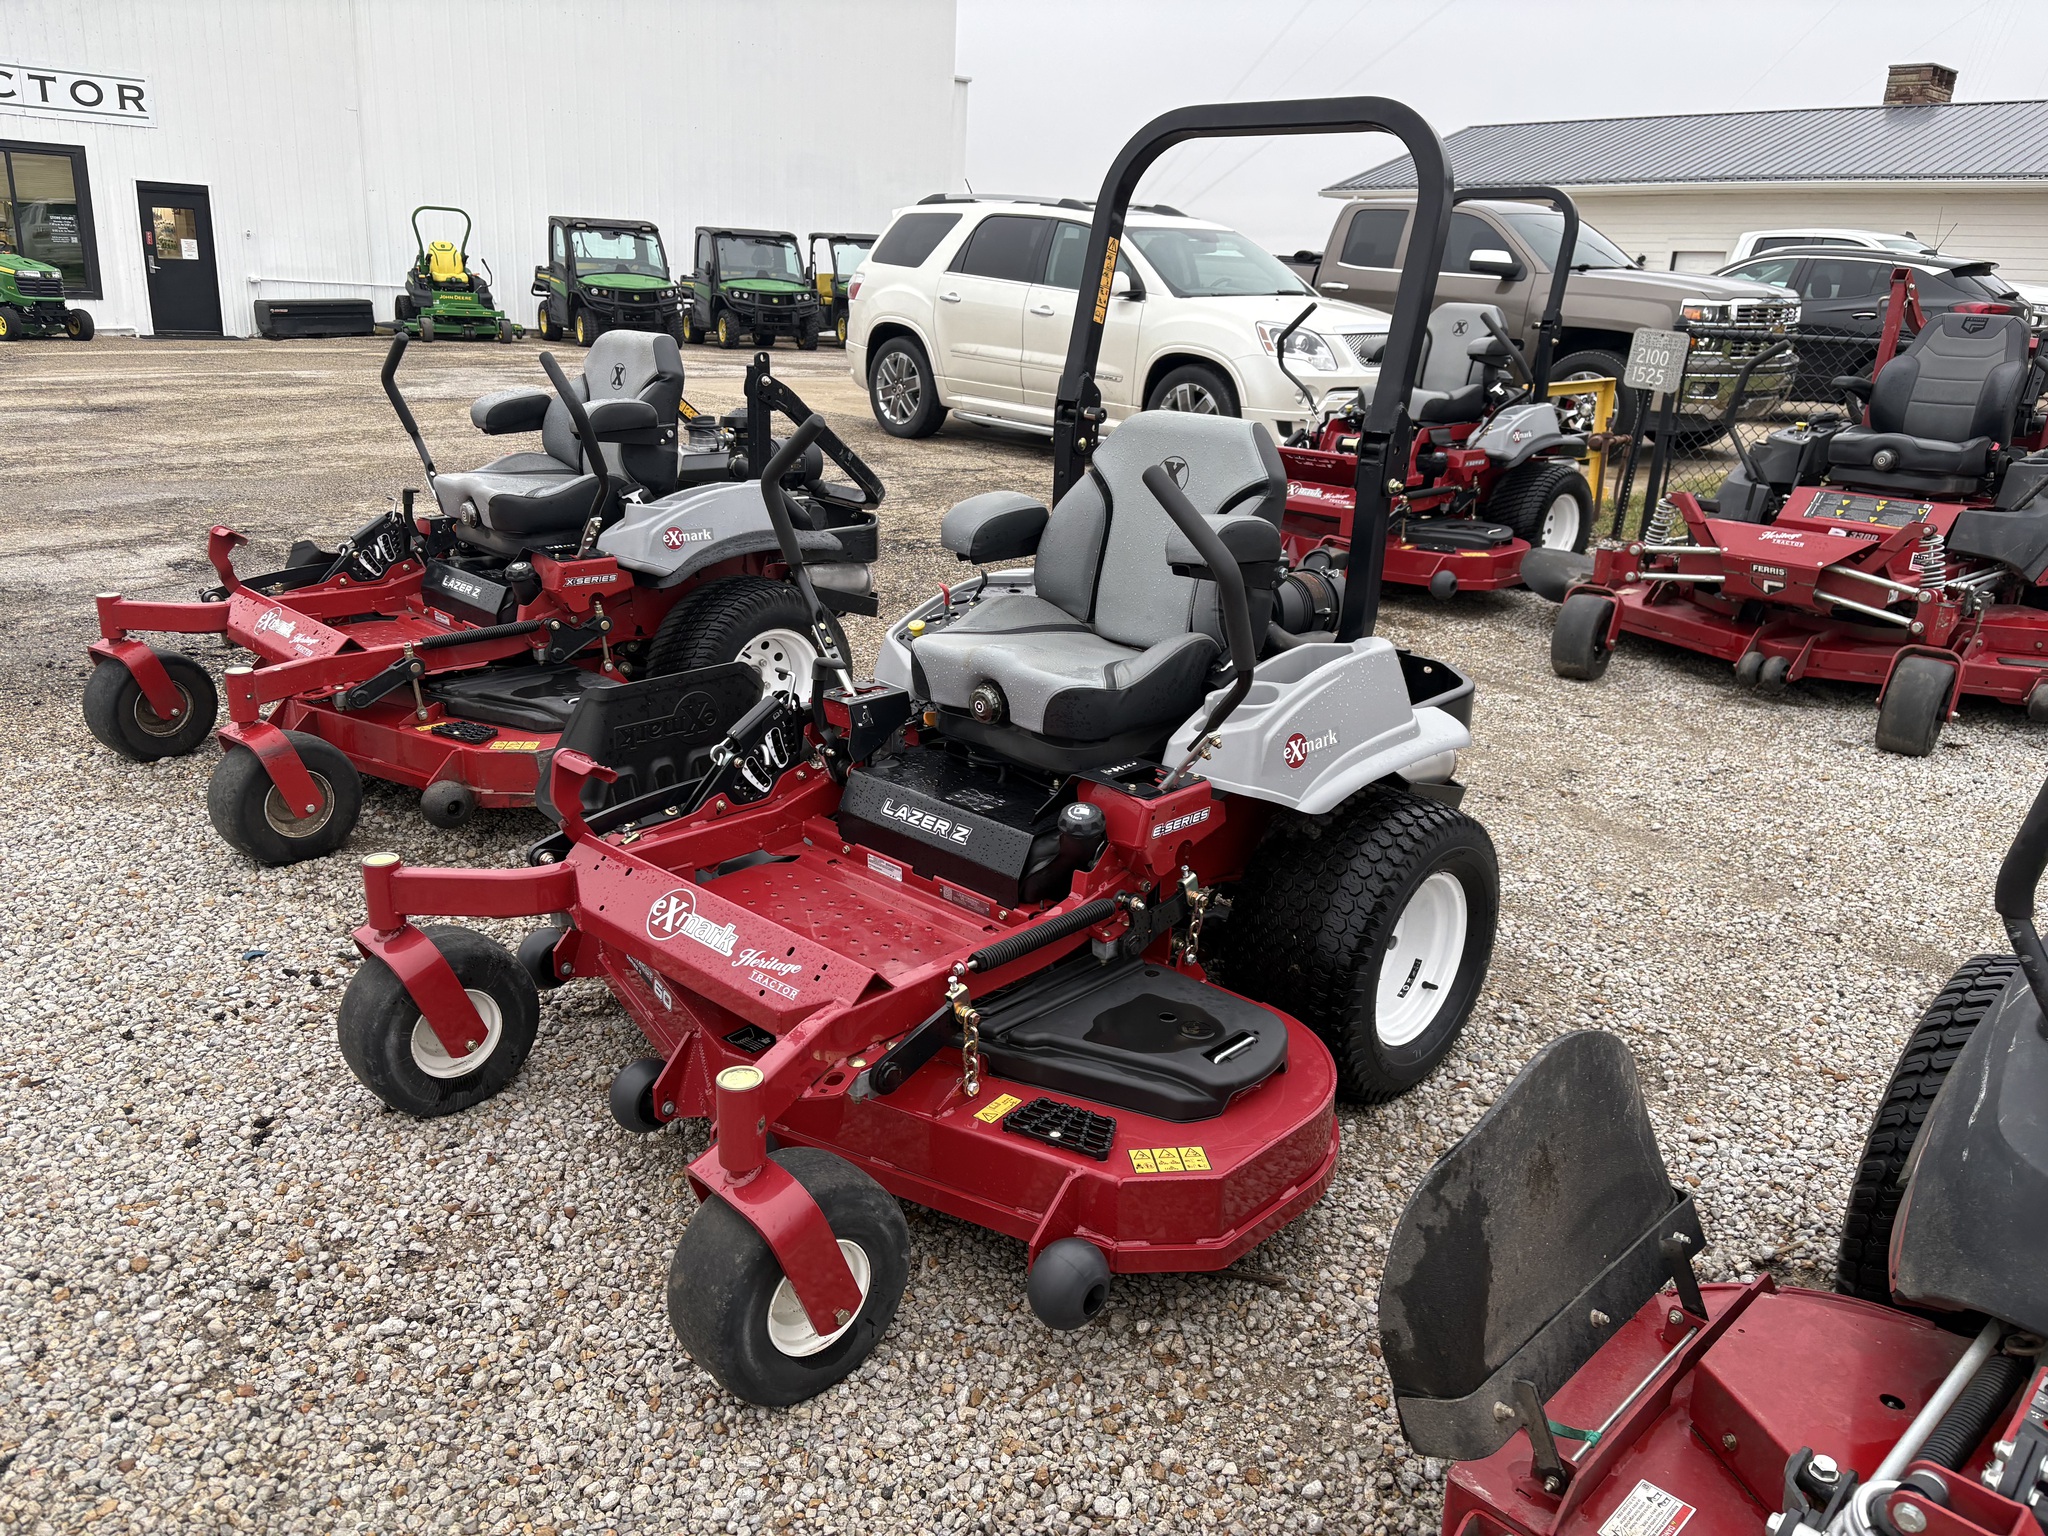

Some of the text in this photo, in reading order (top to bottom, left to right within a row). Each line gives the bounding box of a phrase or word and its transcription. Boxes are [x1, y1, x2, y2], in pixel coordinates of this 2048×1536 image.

[1636, 347, 1669, 367] 2100
[1632, 366, 1665, 385] 1525
[663, 529, 712, 546] eXmark
[1758, 530, 1803, 541] Heritage
[1772, 539, 1805, 548] TRACTOR
[1752, 564, 1785, 576] FERRIS
[442, 575, 482, 599] LAZER Z
[1283, 730, 1338, 763] eXmark
[880, 798, 973, 846] LAZER Z
[650, 894, 740, 957] eXmark
[732, 948, 803, 977] Heritage
[653, 977, 672, 1013] 60
[749, 970, 799, 999] TRACTOR
